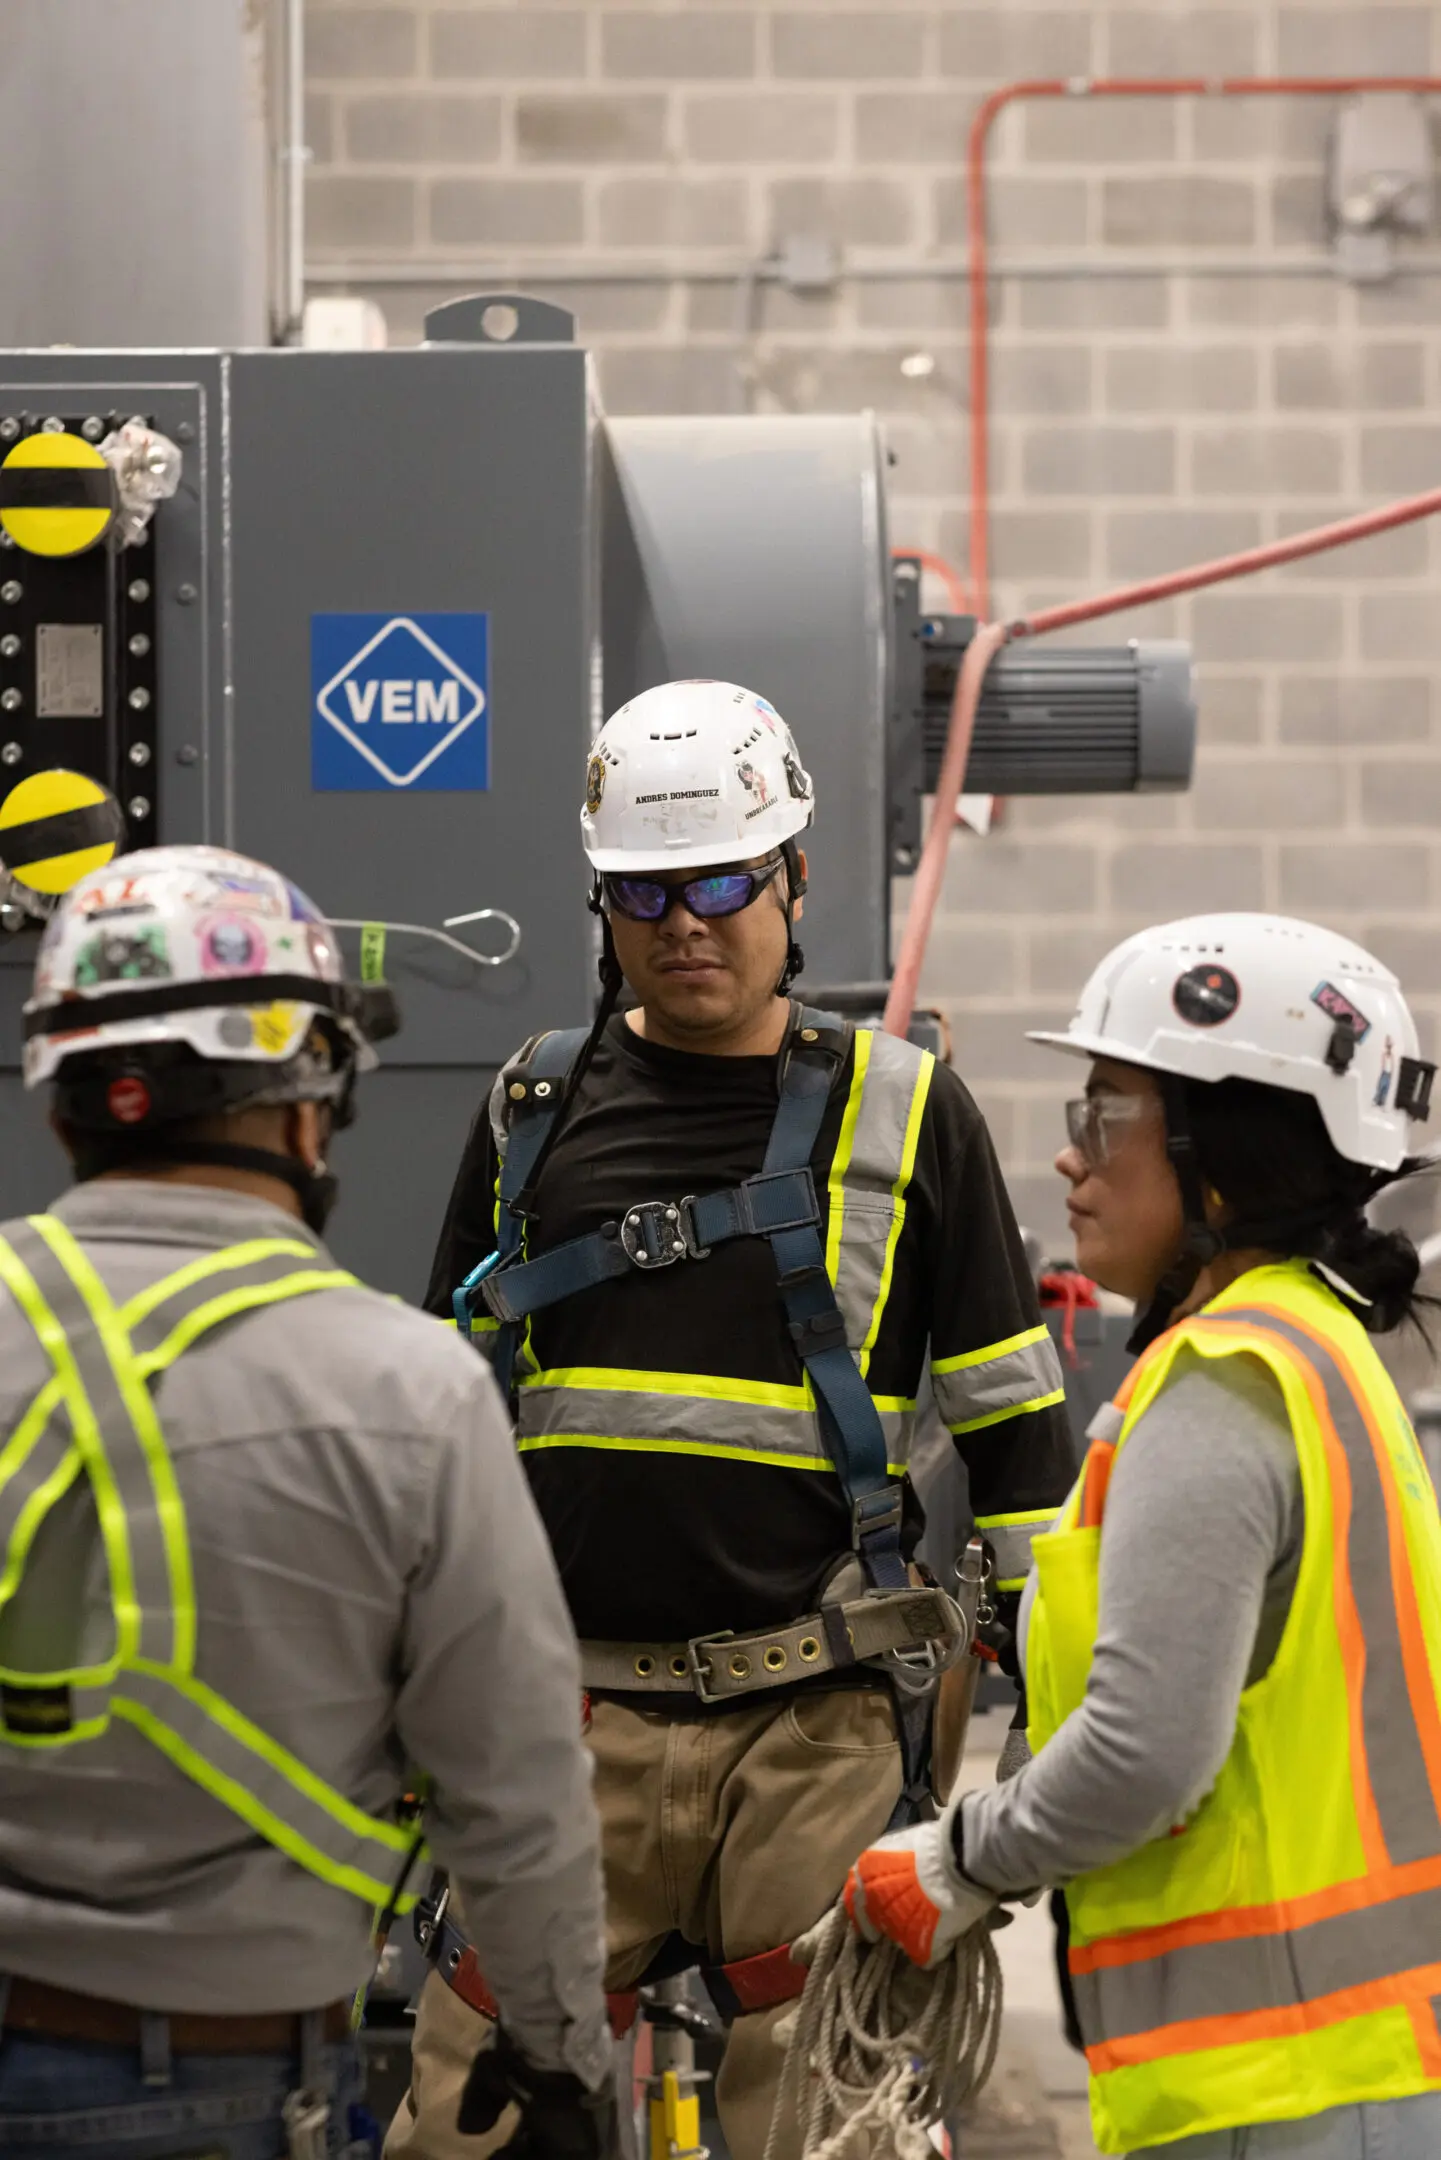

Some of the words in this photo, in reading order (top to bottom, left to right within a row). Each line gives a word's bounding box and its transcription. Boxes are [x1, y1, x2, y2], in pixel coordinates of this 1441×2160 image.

[344, 680, 460, 723] VEM
[635, 793, 668, 805] ANDRES
[670, 788, 720, 800] DOMINGUEZ
